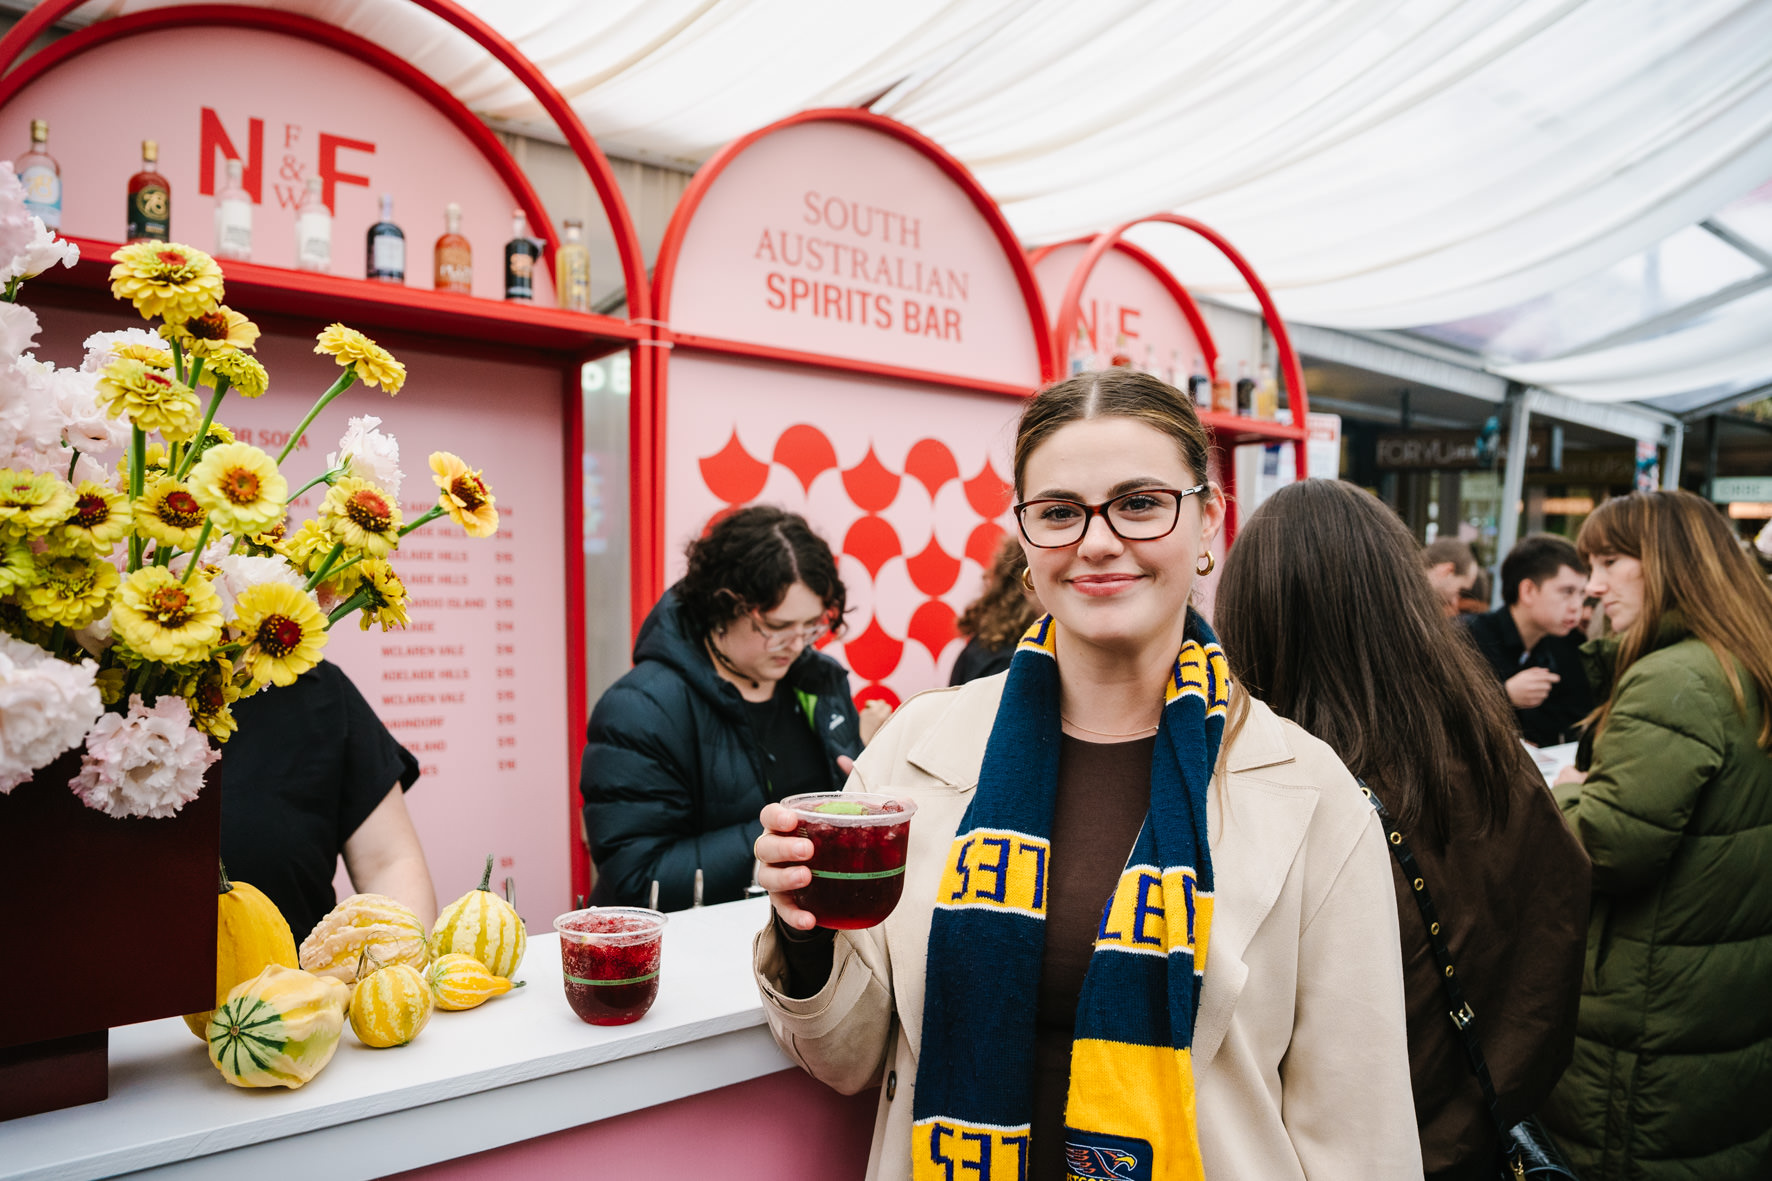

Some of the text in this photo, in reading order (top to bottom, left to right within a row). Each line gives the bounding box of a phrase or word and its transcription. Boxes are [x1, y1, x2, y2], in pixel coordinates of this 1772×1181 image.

[200, 106, 264, 204] N
[284, 123, 302, 149] F
[280, 155, 306, 182] &
[803, 190, 921, 249] SOUTH
[755, 228, 970, 301] AUSTRALIAN
[765, 272, 963, 342] SPIRITS BAR
